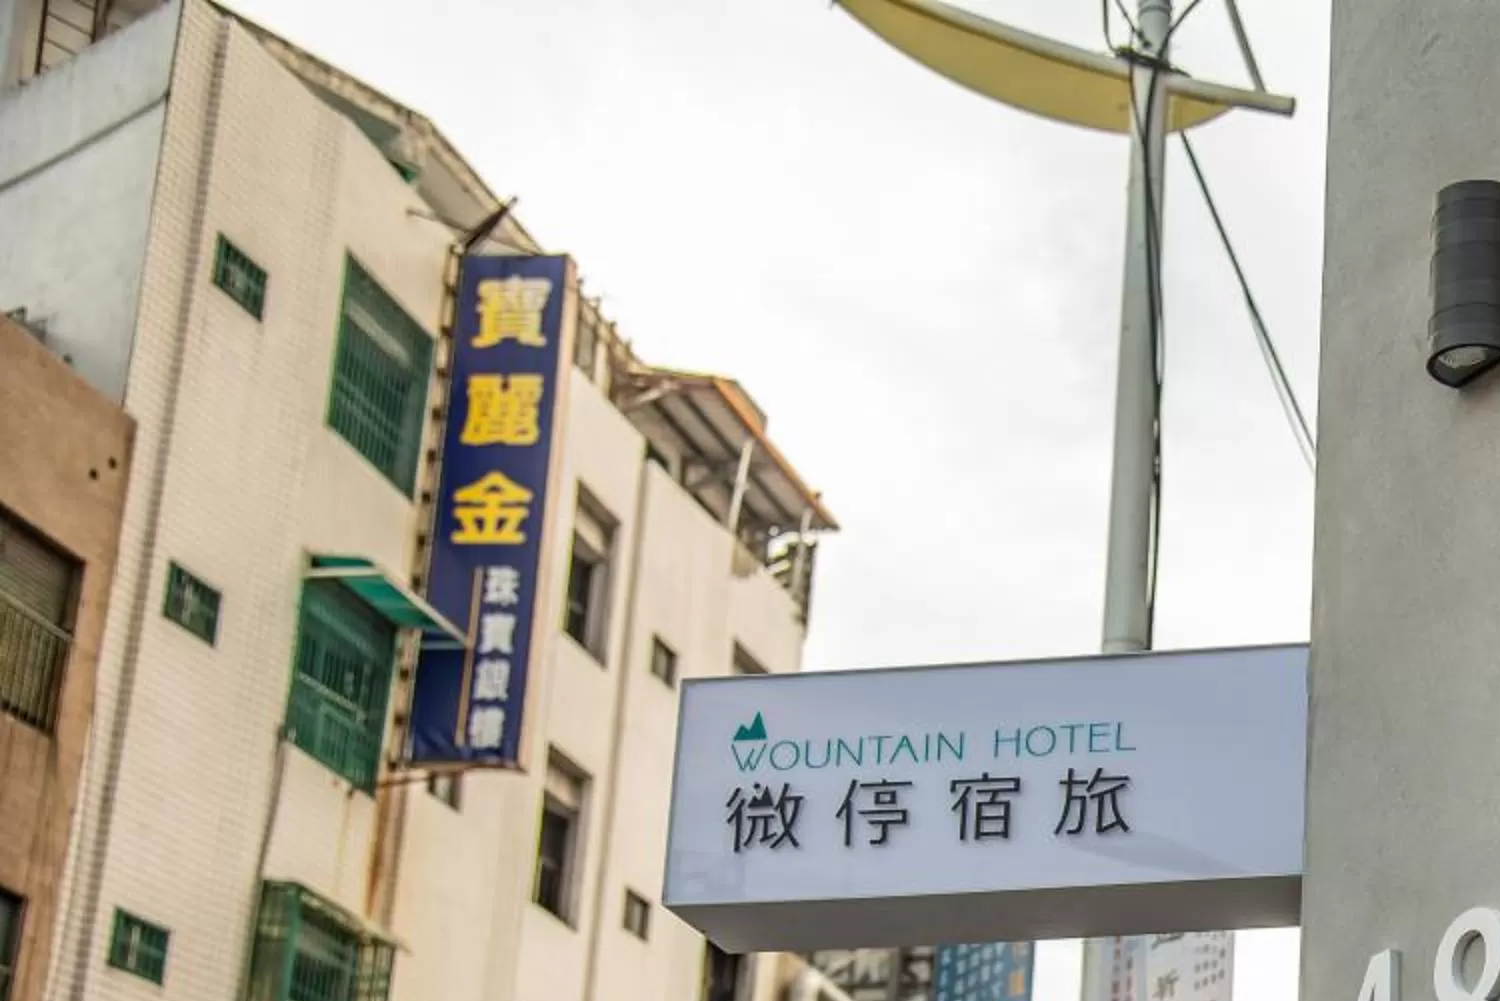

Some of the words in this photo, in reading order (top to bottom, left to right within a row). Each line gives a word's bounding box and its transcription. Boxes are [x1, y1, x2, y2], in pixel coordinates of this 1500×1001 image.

[731, 730, 965, 772] WOUNTAIN
[994, 720, 1137, 759] HOTEL
[726, 767, 1132, 853] 微停宿旅
